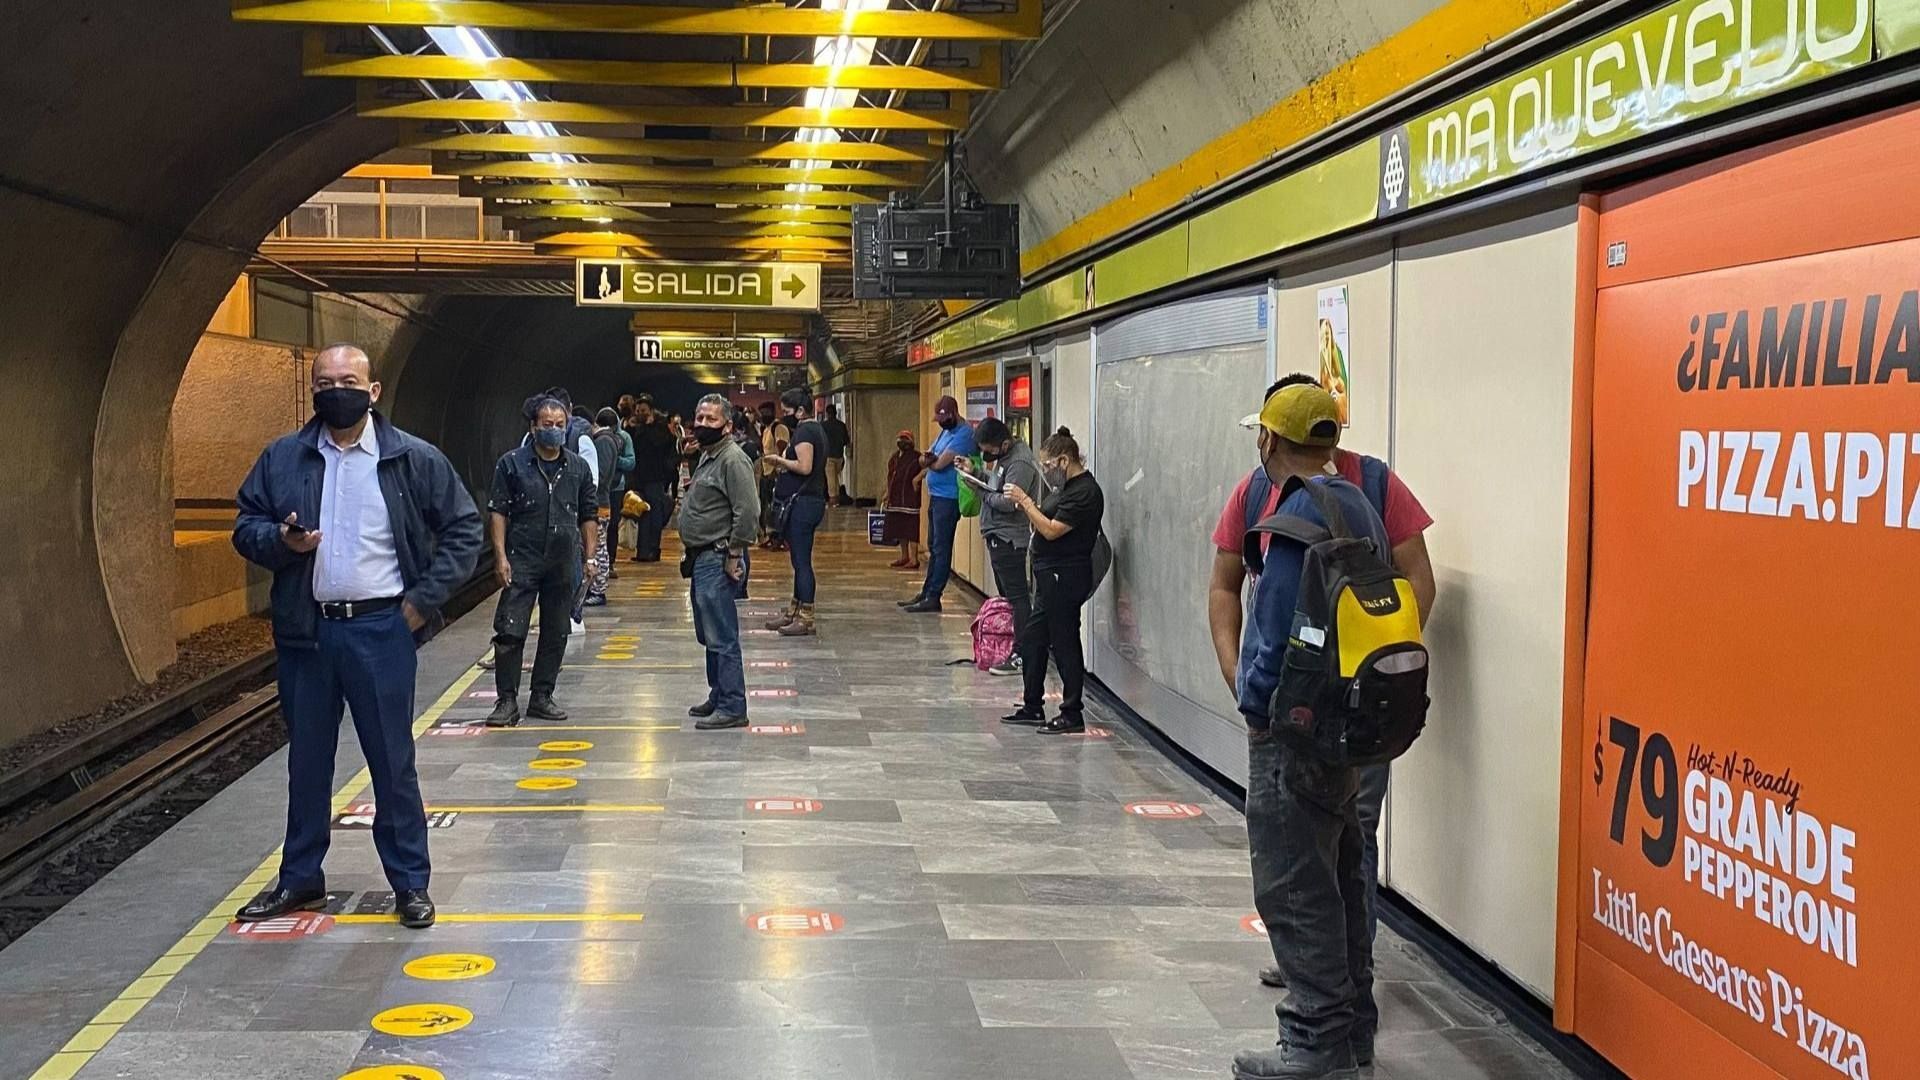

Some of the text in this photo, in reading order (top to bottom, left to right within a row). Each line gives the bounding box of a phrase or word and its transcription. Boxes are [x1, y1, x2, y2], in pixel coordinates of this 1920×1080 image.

[632, 272, 761, 297] SALIDA
[662, 350, 759, 360] INDIOS VERDES
[794, 345, 802, 357] 3
[1686, 742, 1800, 816] Hot-N-Ready
[1683, 768, 1857, 905] GRANDE
[1683, 835, 1859, 969] PEPPERONI
[1592, 866, 1869, 1080] Little Caesars Pizza
